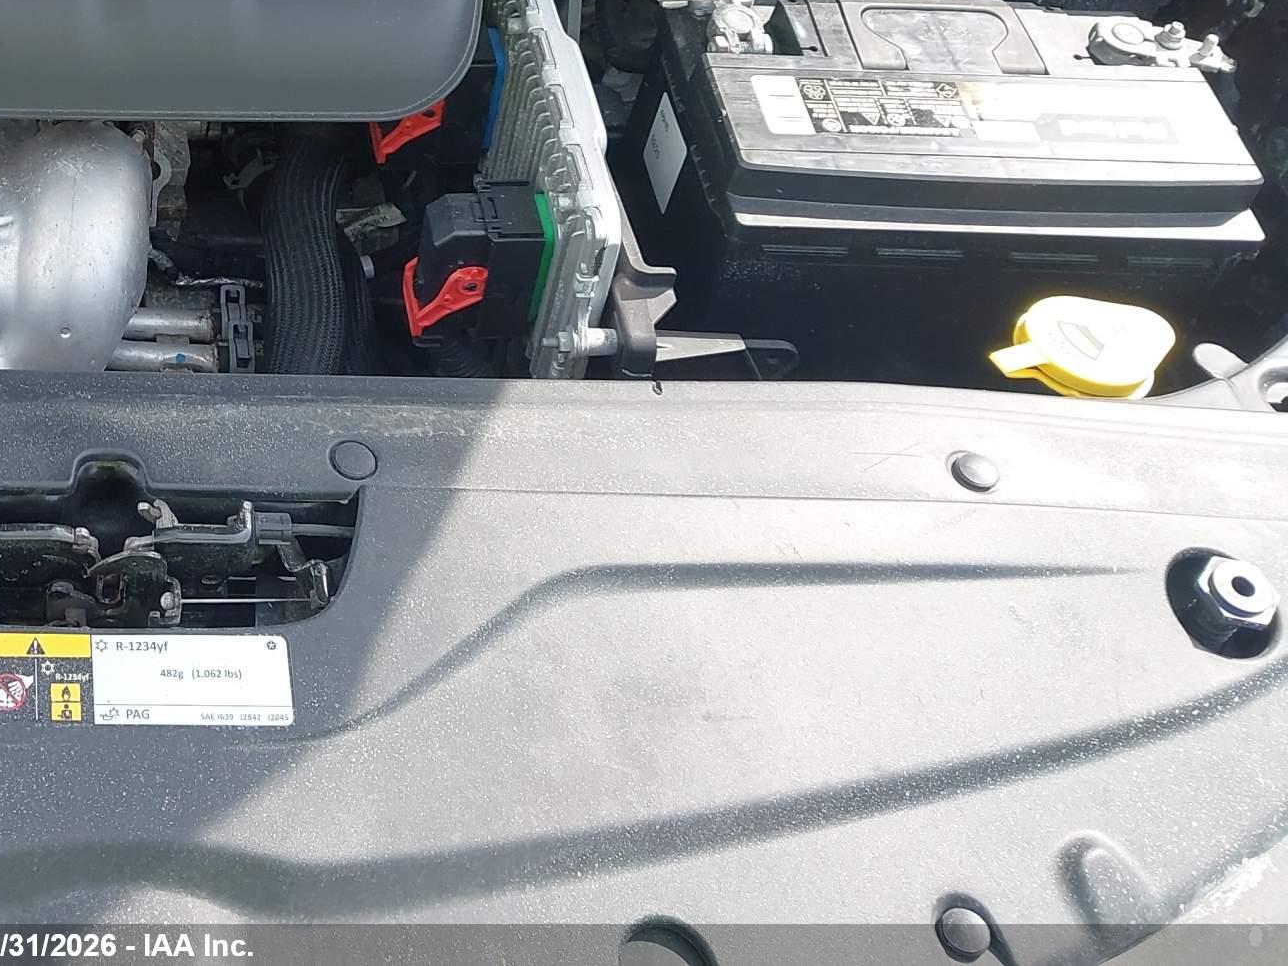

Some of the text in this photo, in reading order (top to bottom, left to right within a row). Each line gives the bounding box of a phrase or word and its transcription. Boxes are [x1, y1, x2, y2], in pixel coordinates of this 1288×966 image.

[116, 641, 169, 654] R-1234yf
[160, 669, 242, 680] 482g (1.062 lbs)
[126, 708, 150, 720] PAG
